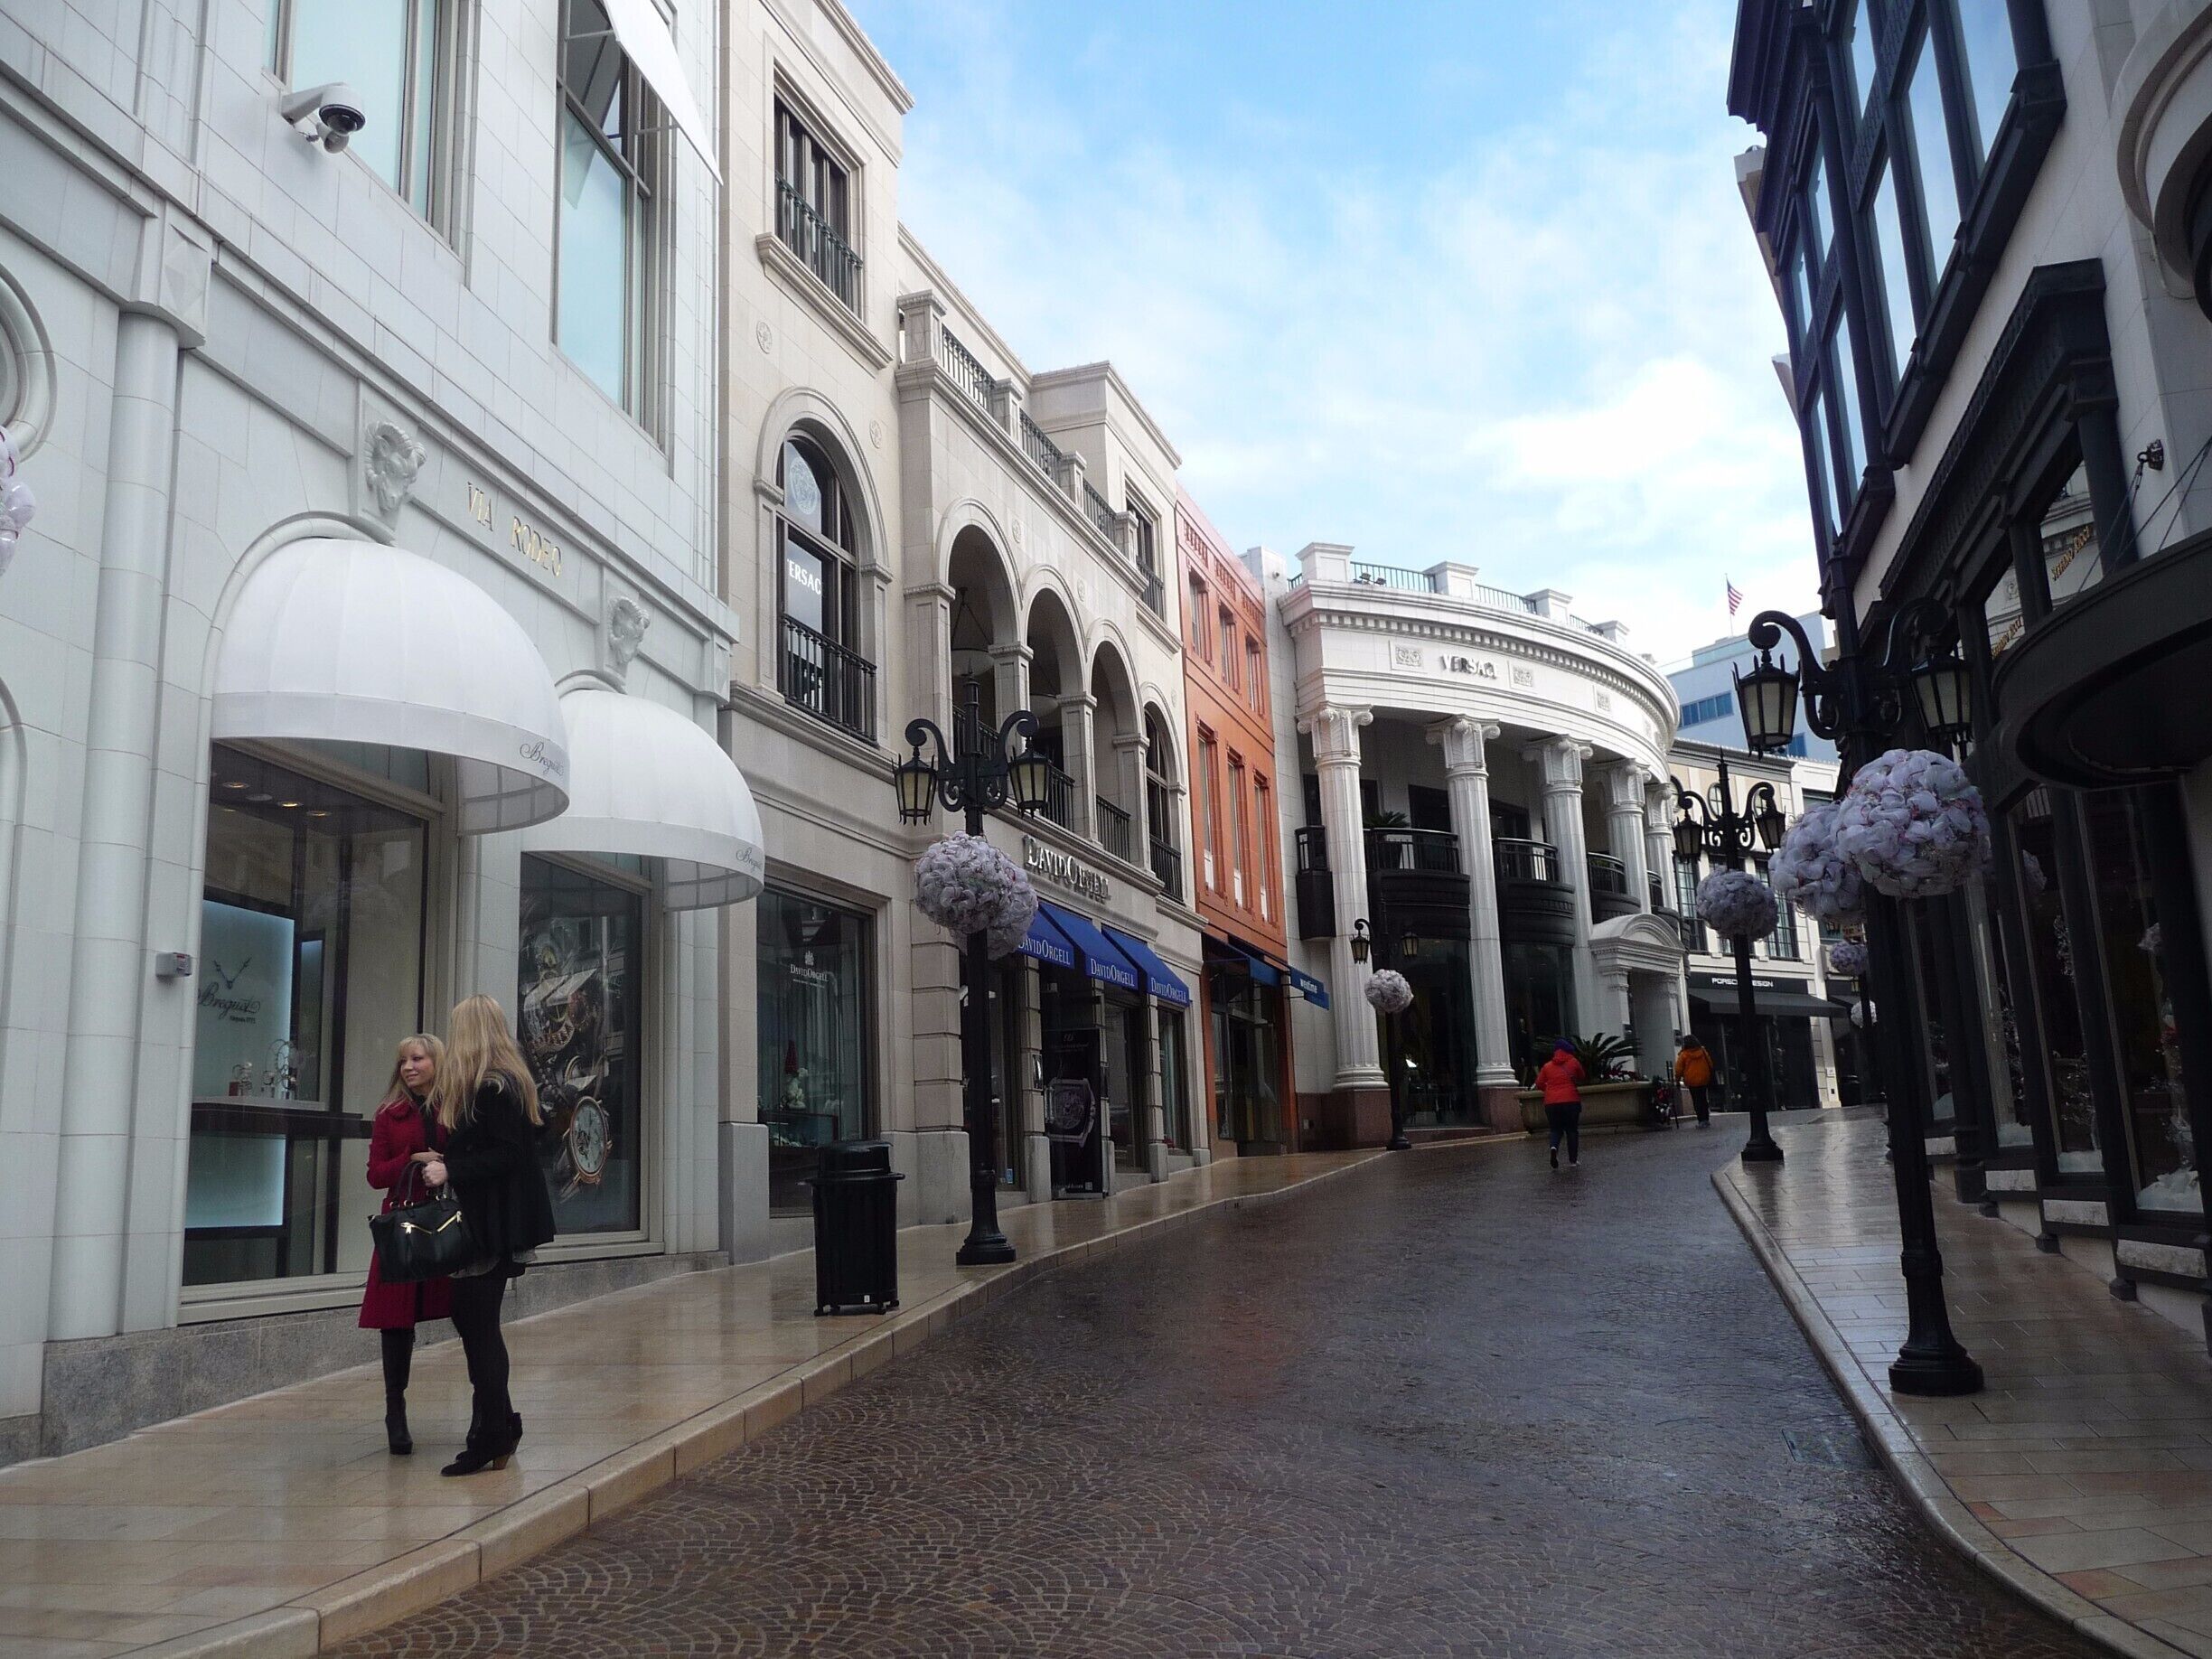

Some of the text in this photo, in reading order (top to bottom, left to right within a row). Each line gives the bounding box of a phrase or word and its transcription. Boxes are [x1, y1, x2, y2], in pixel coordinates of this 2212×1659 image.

[467, 481, 561, 576] VIA RODEO
[786, 558, 821, 595] ERSAC
[198, 981, 261, 1020] Breguet
[1711, 977, 1774, 988] PORSC ESIGN
